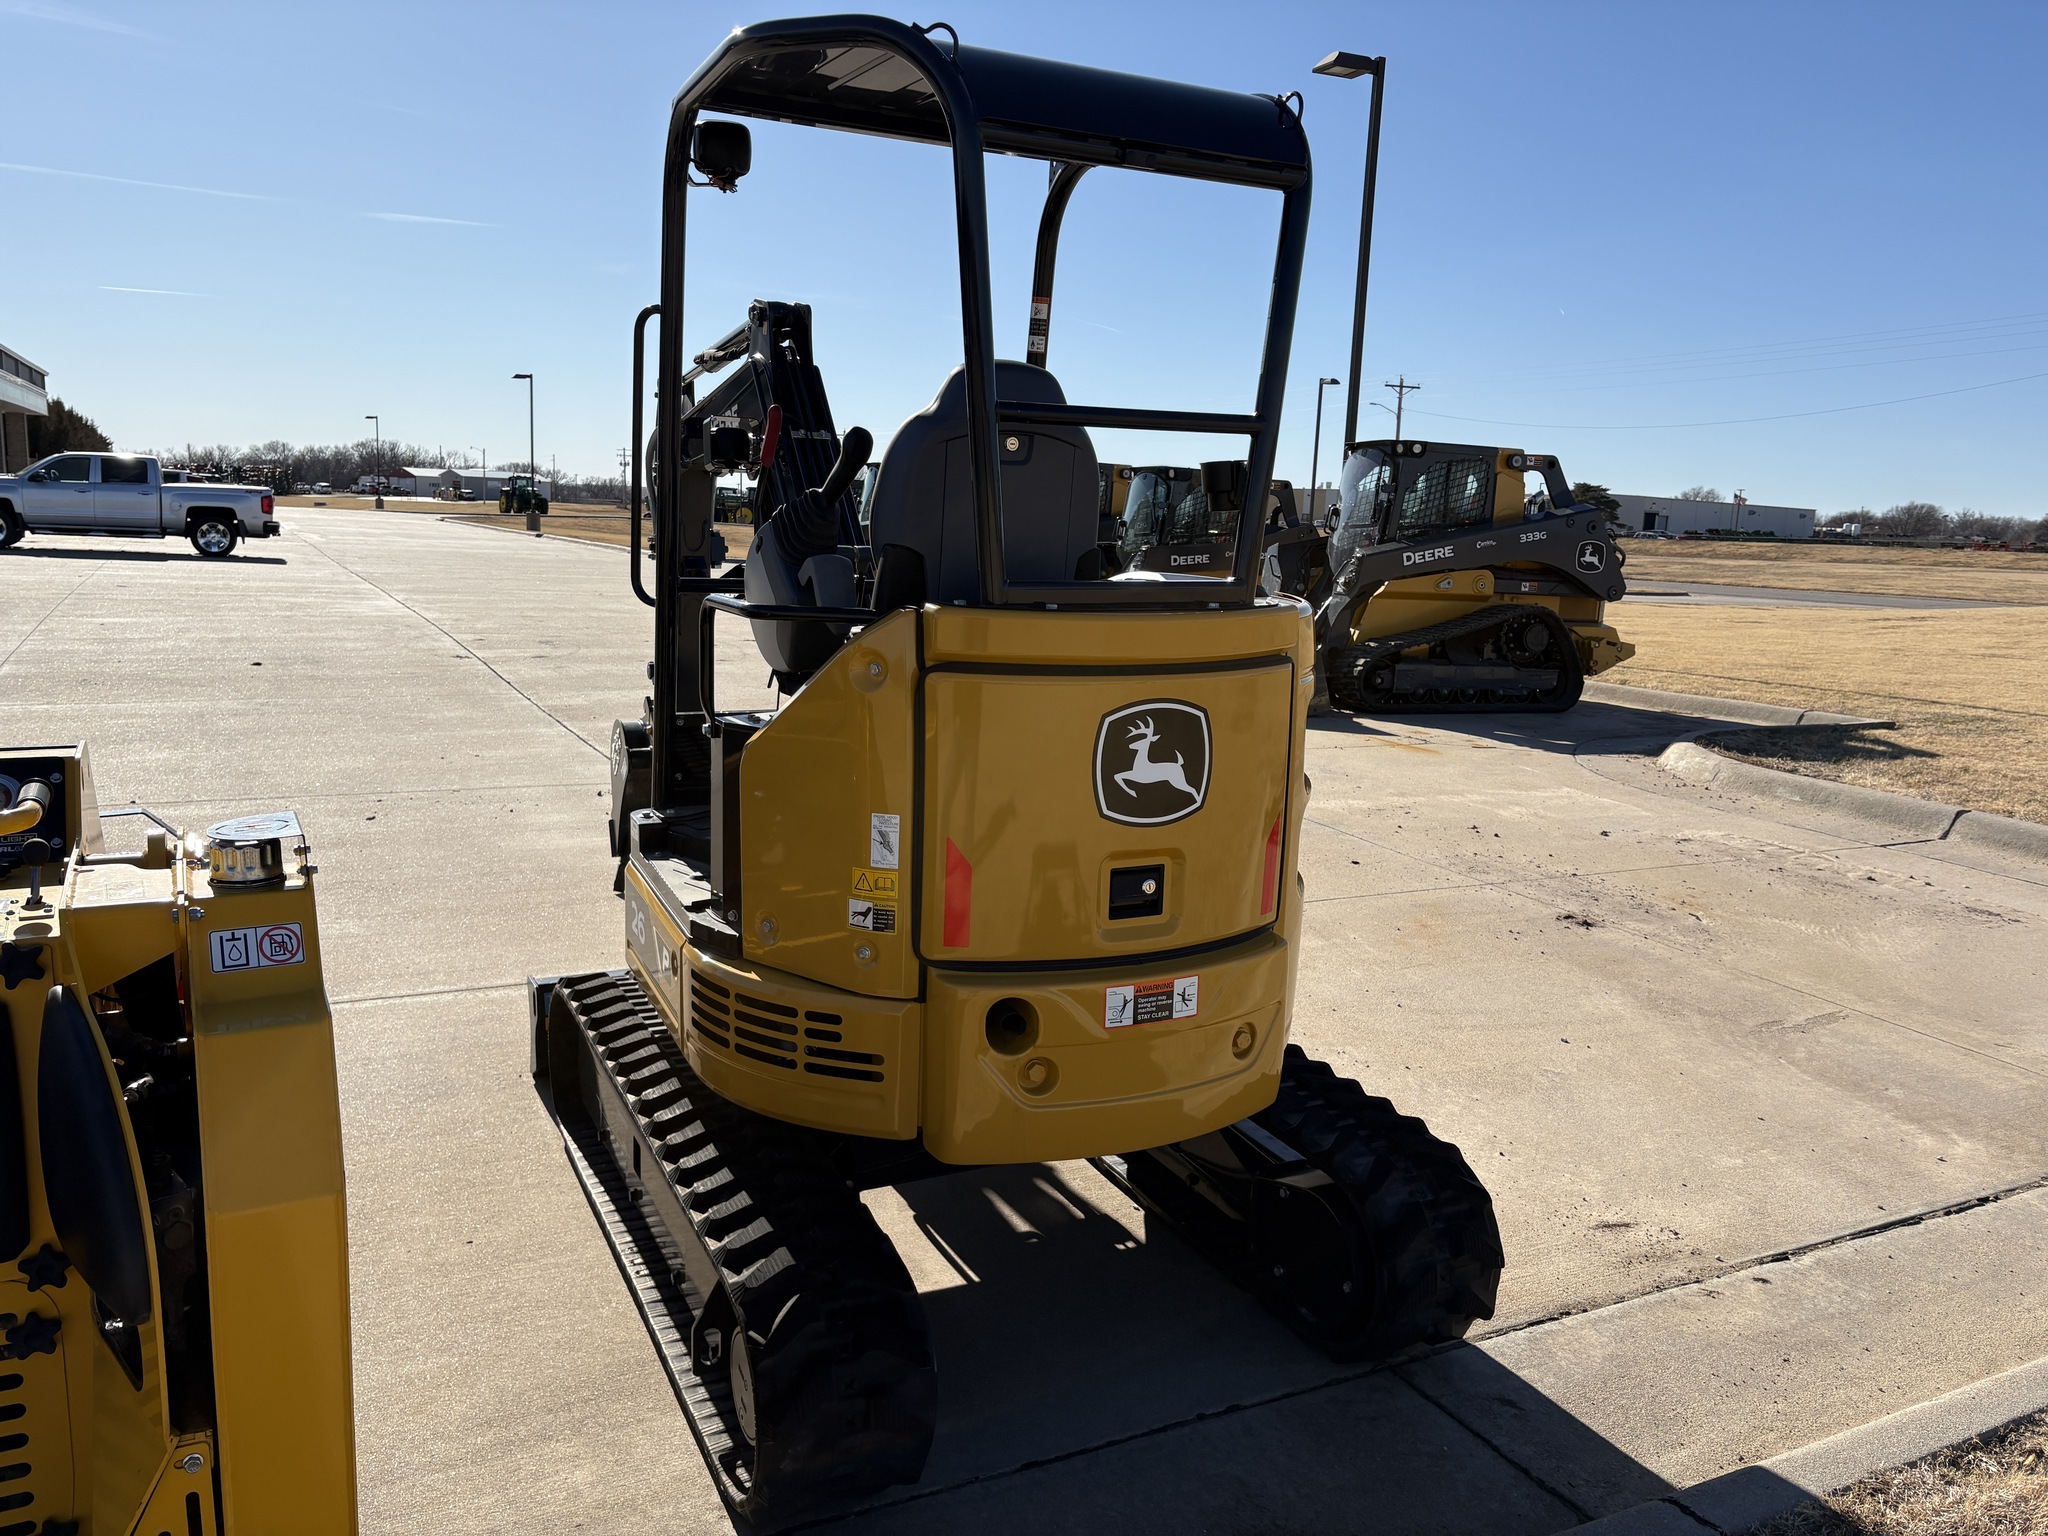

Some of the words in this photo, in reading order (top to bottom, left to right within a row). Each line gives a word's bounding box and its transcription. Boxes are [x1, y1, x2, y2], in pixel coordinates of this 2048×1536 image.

[1519, 531, 1547, 543] 333G
[1170, 554, 1210, 566] DEERE
[1402, 545, 1454, 567] DEERE
[631, 900, 646, 945] 26
[1142, 982, 1173, 993] WARNING
[1151, 1010, 1170, 1018] CLEAR
